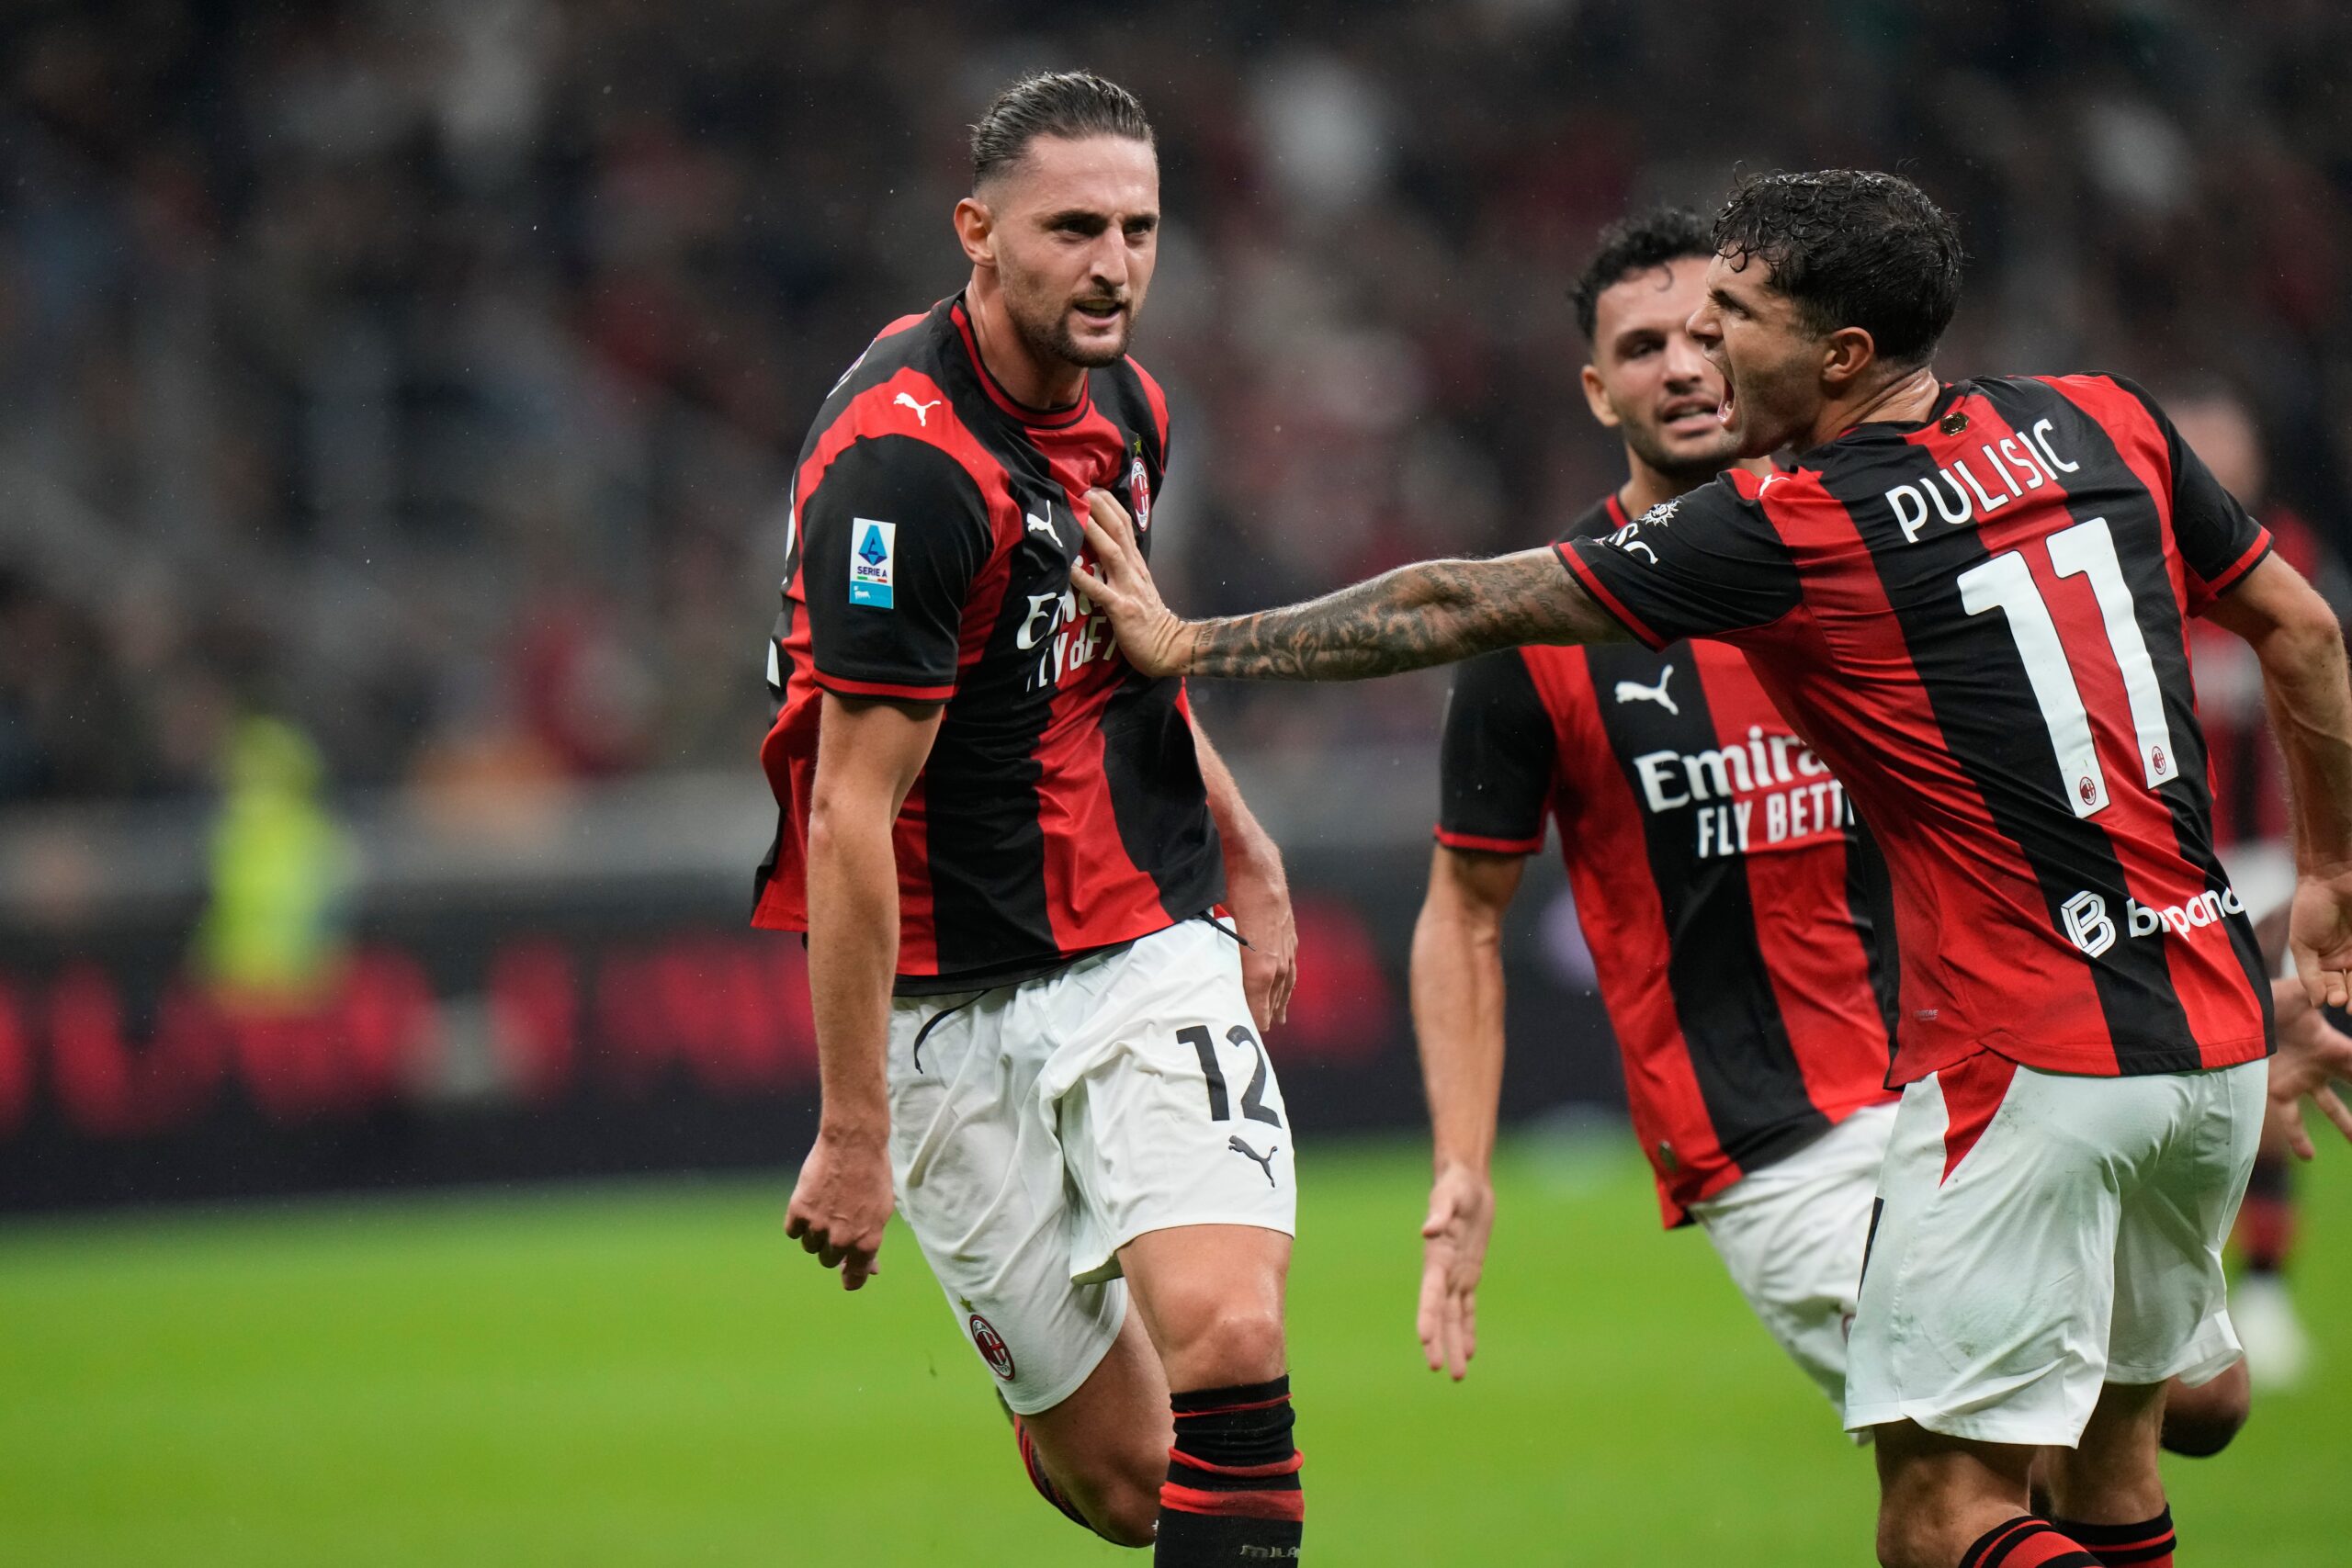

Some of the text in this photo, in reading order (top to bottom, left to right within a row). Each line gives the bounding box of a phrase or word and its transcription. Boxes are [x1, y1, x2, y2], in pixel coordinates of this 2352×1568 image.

[1885, 418, 2080, 544] PULISIC
[856, 566, 888, 578] SERIE A
[1956, 516, 2179, 819] 11
[1697, 800, 1753, 858] FLY
[1176, 1024, 1283, 1129] 12
